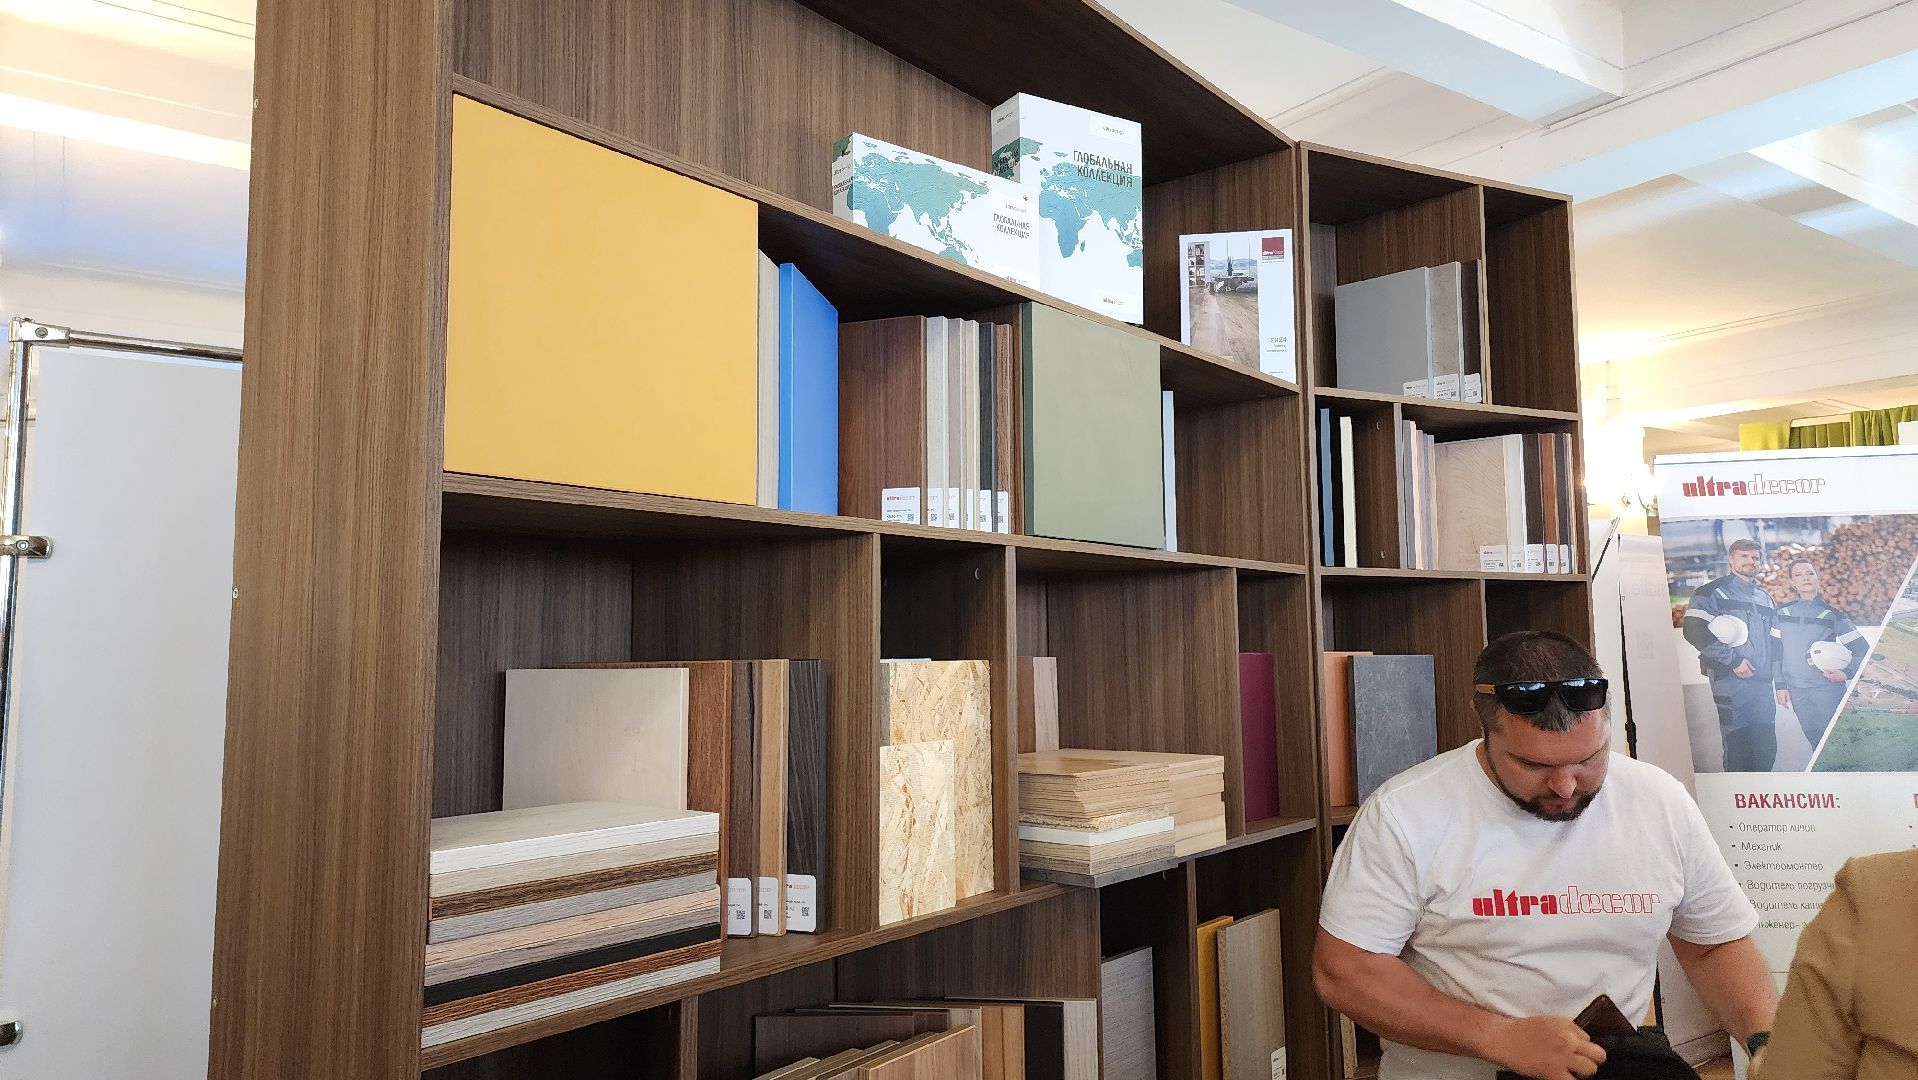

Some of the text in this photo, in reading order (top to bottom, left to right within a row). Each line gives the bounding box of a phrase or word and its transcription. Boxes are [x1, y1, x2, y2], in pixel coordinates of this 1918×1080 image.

[1073, 150, 1133, 175] ГЛОБАЛЬНАЯ
[1077, 165, 1133, 188] КОЛЛЕКЦИЯ
[1682, 473, 1826, 498] ultradecor
[1734, 793, 1841, 809] ВАКАНСИИ:
[1738, 822, 1788, 833] Оператор
[1741, 841, 1783, 851] Механик
[1743, 860, 1824, 872] Электромонтер
[1747, 879, 1795, 892] Водитель
[1472, 885, 1661, 917] ultradecor
